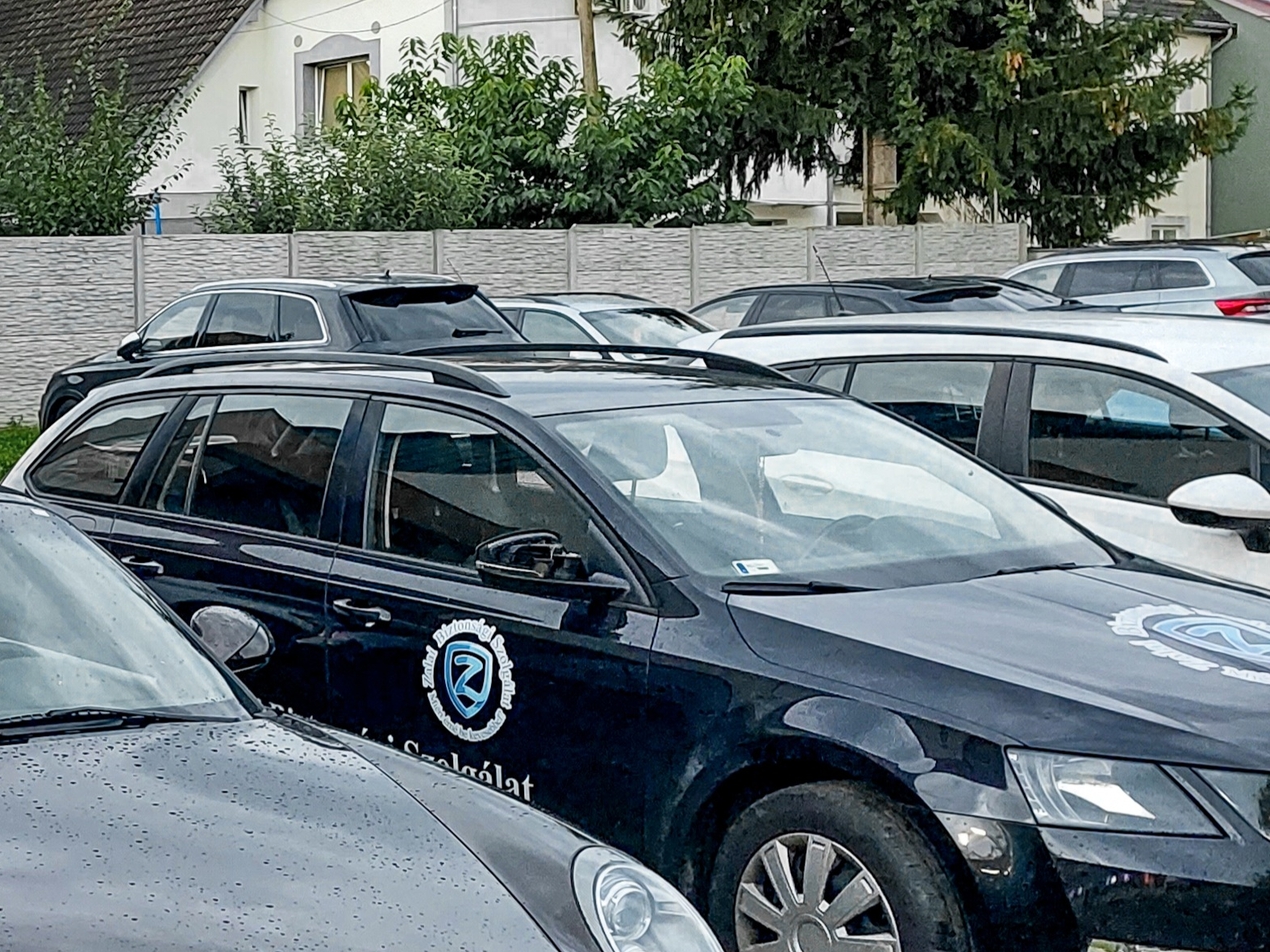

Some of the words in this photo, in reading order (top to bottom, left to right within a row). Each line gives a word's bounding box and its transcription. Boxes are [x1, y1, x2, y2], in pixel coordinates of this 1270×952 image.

[422, 645, 438, 688] Zalai
[433, 618, 496, 648] Biztonsági
[490, 634, 516, 710] Szolgálat
